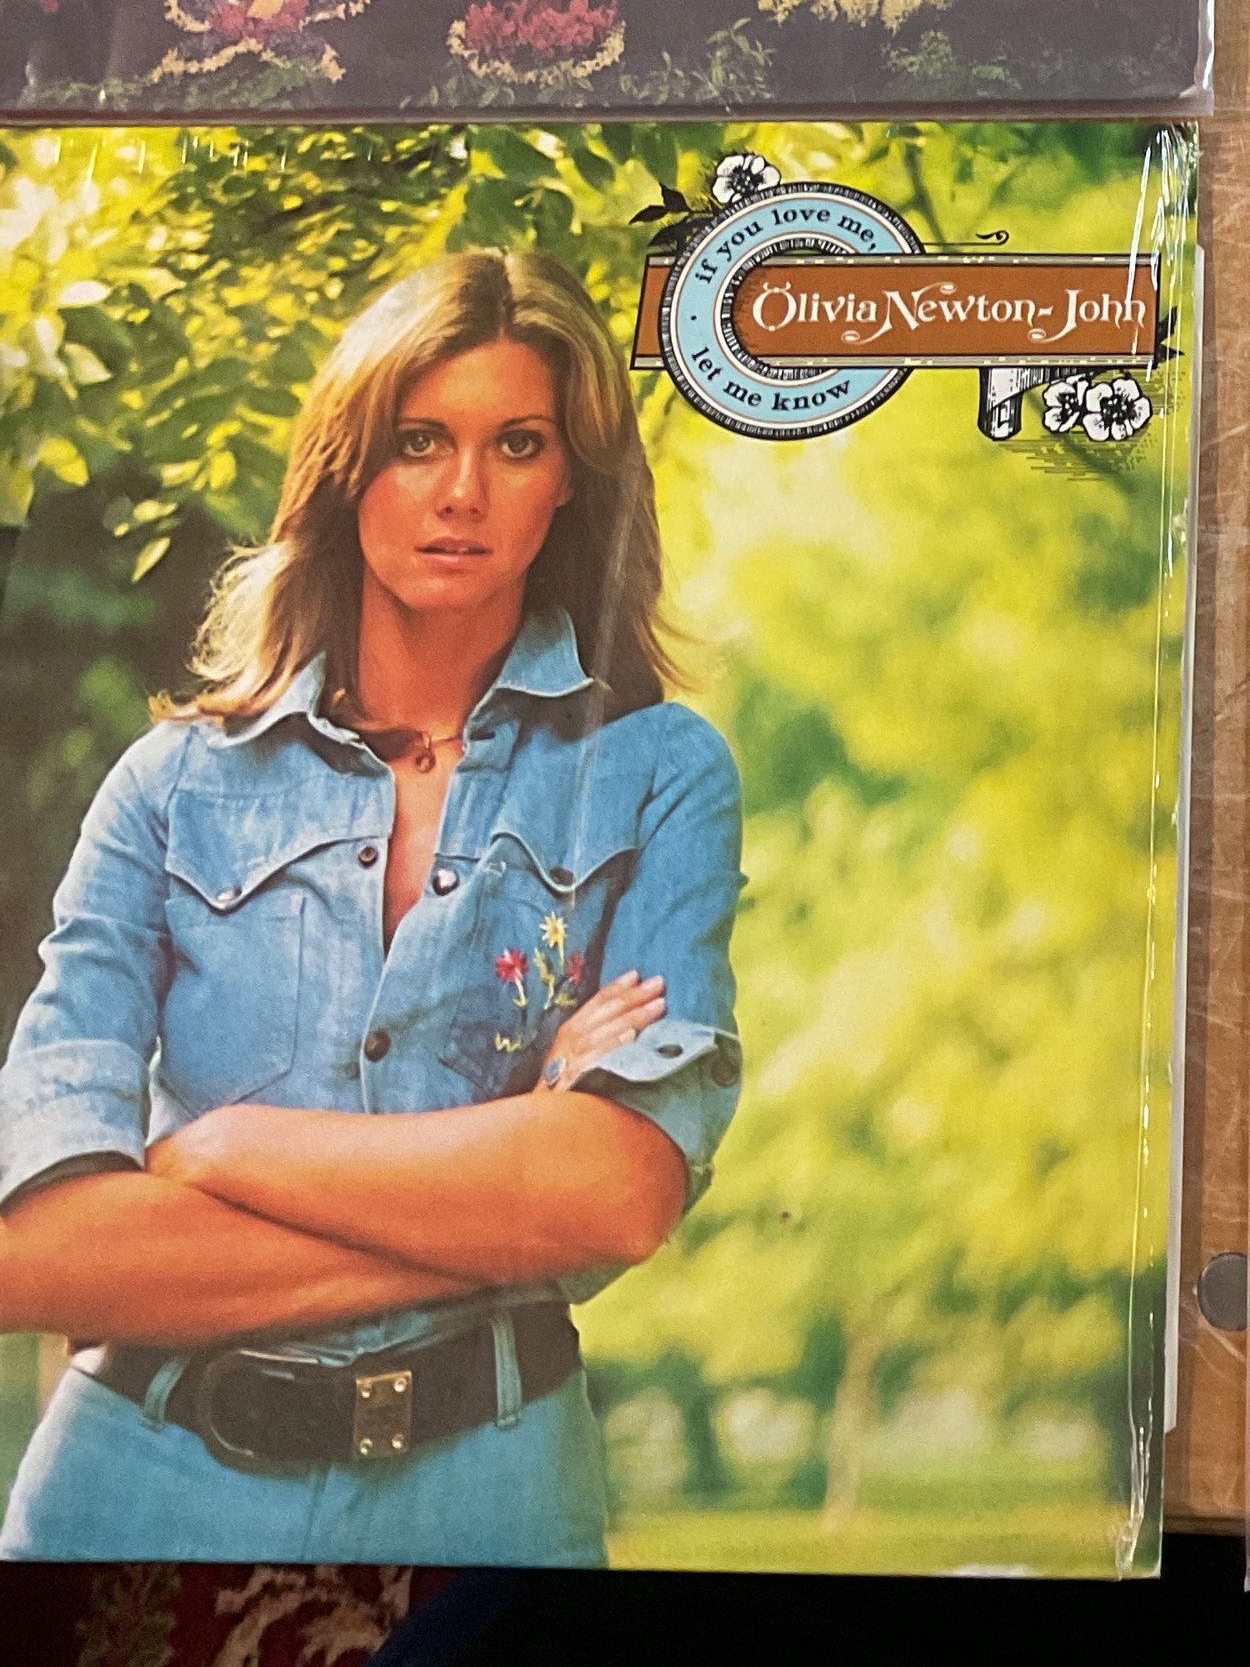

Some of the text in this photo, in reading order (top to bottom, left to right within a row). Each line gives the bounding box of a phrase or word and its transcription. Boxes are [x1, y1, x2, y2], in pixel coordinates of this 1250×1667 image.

[695, 208, 877, 284] if you love me,
[691, 346, 851, 411] let me know
